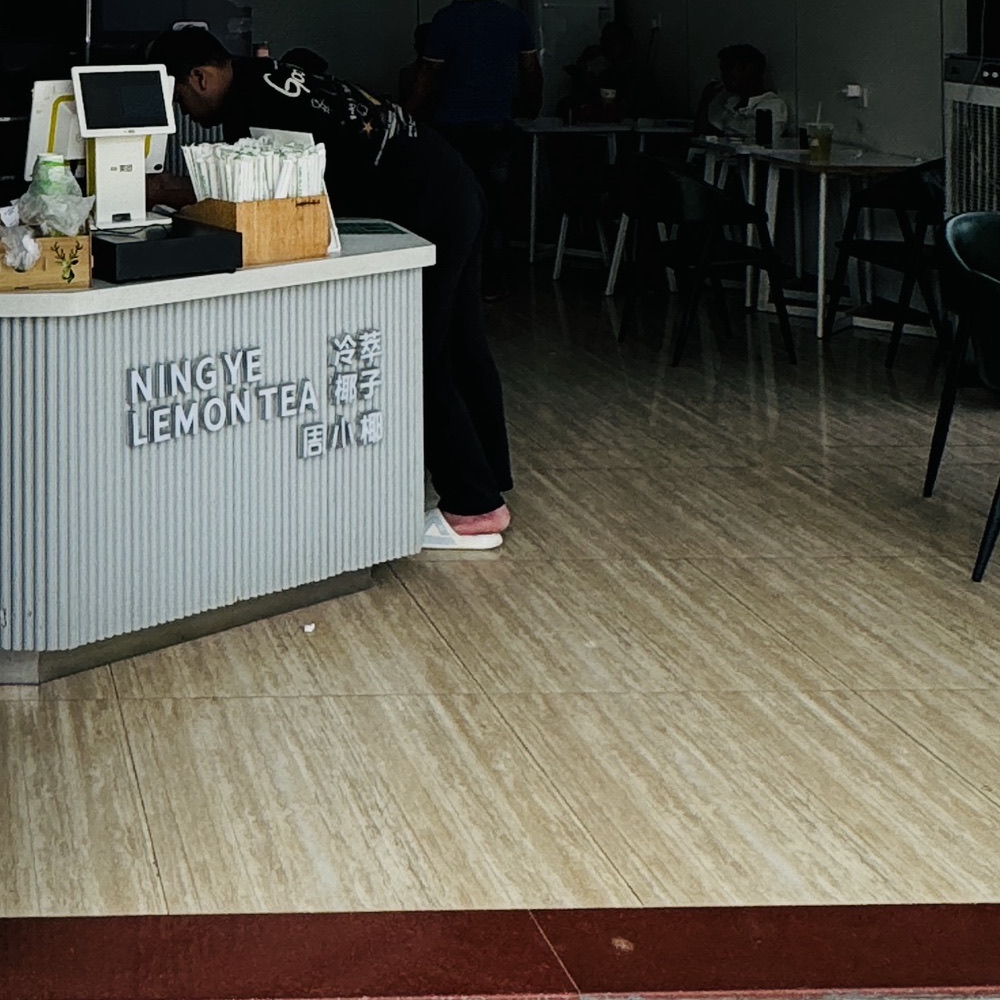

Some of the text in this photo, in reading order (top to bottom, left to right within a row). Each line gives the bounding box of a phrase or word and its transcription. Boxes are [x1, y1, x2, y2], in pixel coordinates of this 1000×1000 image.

[333, 329, 382, 367] 冷萃
[334, 369, 382, 405] 椰子
[131, 381, 319, 446] LEMON TEA
[302, 410, 384, 458] 周小椰
